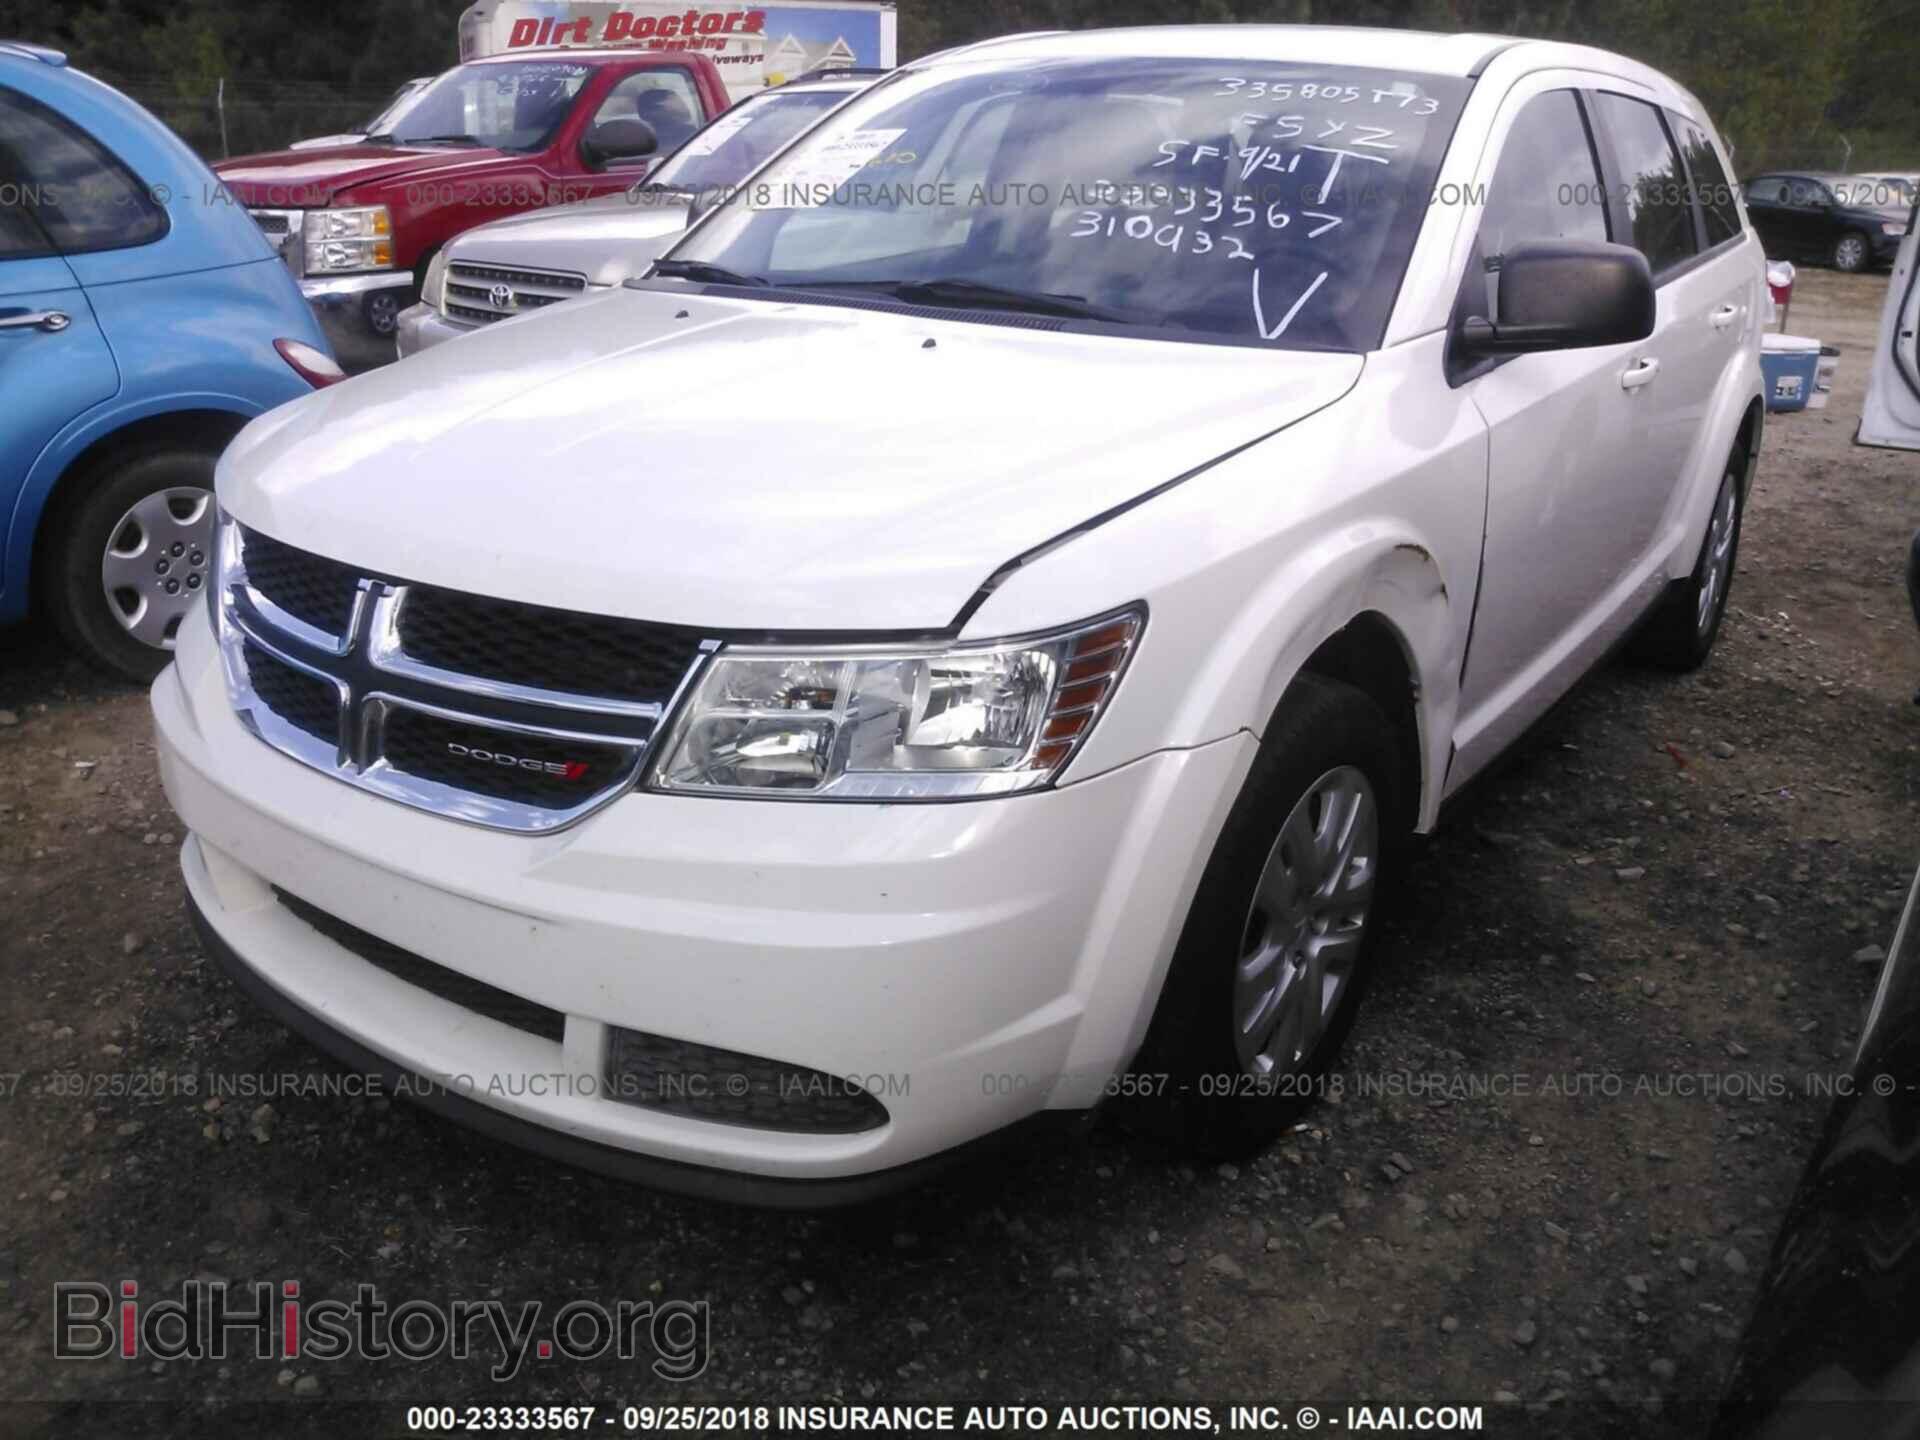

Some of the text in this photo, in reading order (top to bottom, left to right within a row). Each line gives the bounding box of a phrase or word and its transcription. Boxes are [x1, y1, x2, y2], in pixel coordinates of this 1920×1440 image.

[508, 9, 766, 48] Dirt Doctors
[448, 742, 569, 776] DODGE
